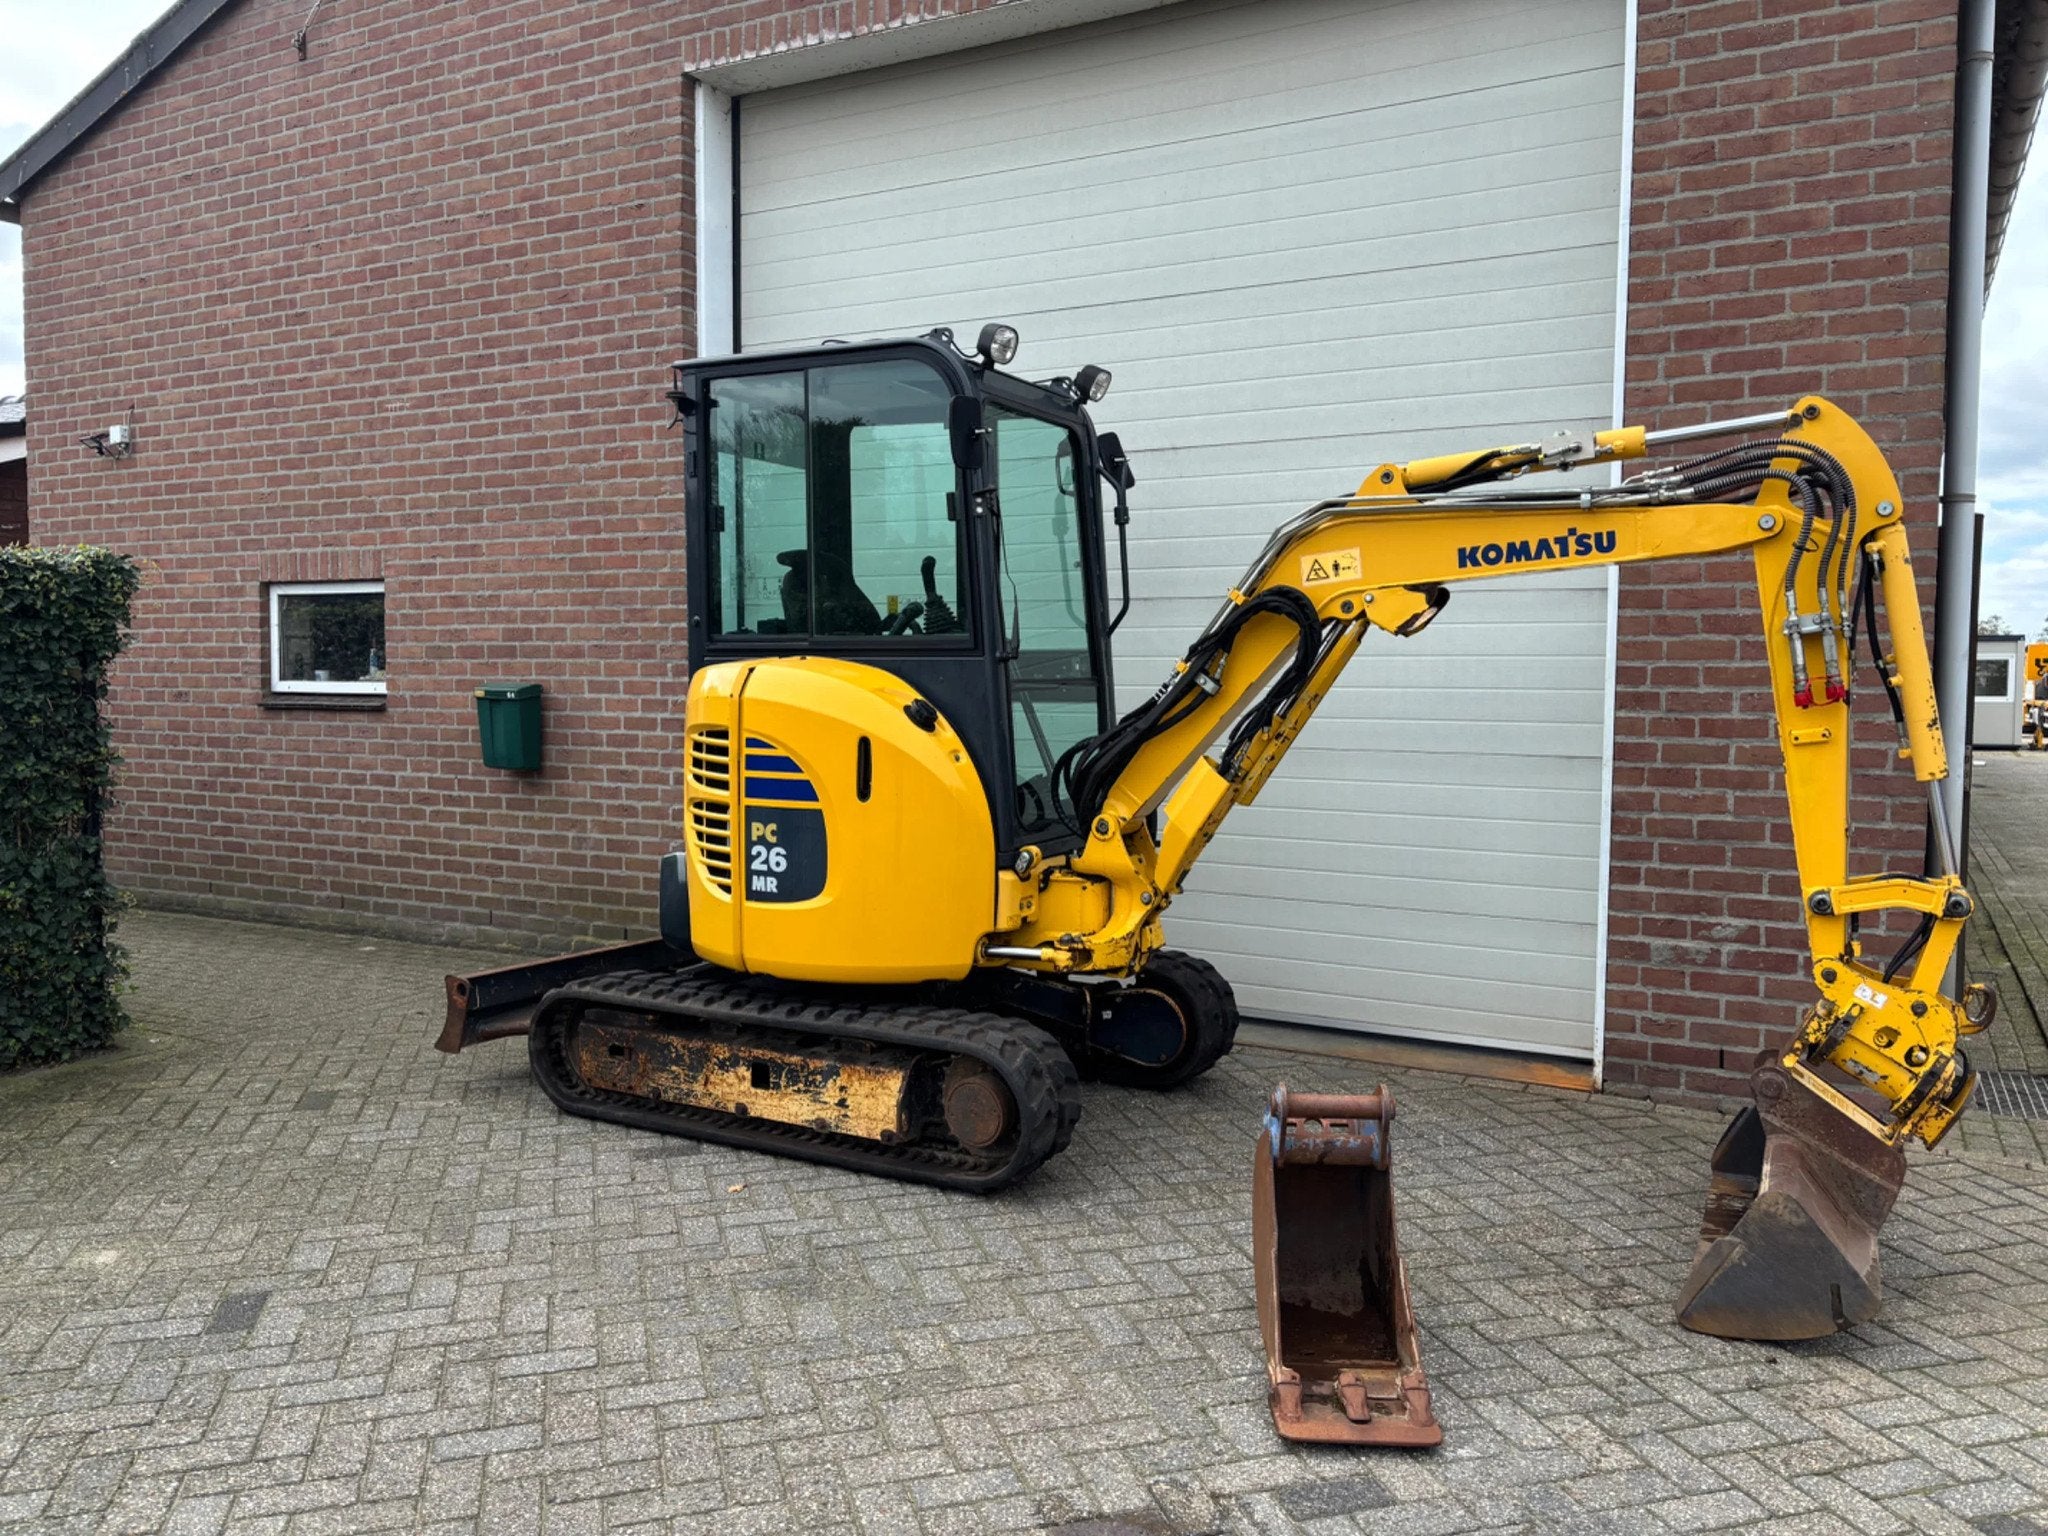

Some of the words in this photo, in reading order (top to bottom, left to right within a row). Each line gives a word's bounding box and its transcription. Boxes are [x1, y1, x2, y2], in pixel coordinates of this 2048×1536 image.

[1458, 528, 1617, 569] KOMATSU
[751, 822, 778, 843] PC
[750, 845, 788, 873] 26
[751, 875, 778, 893] MR
